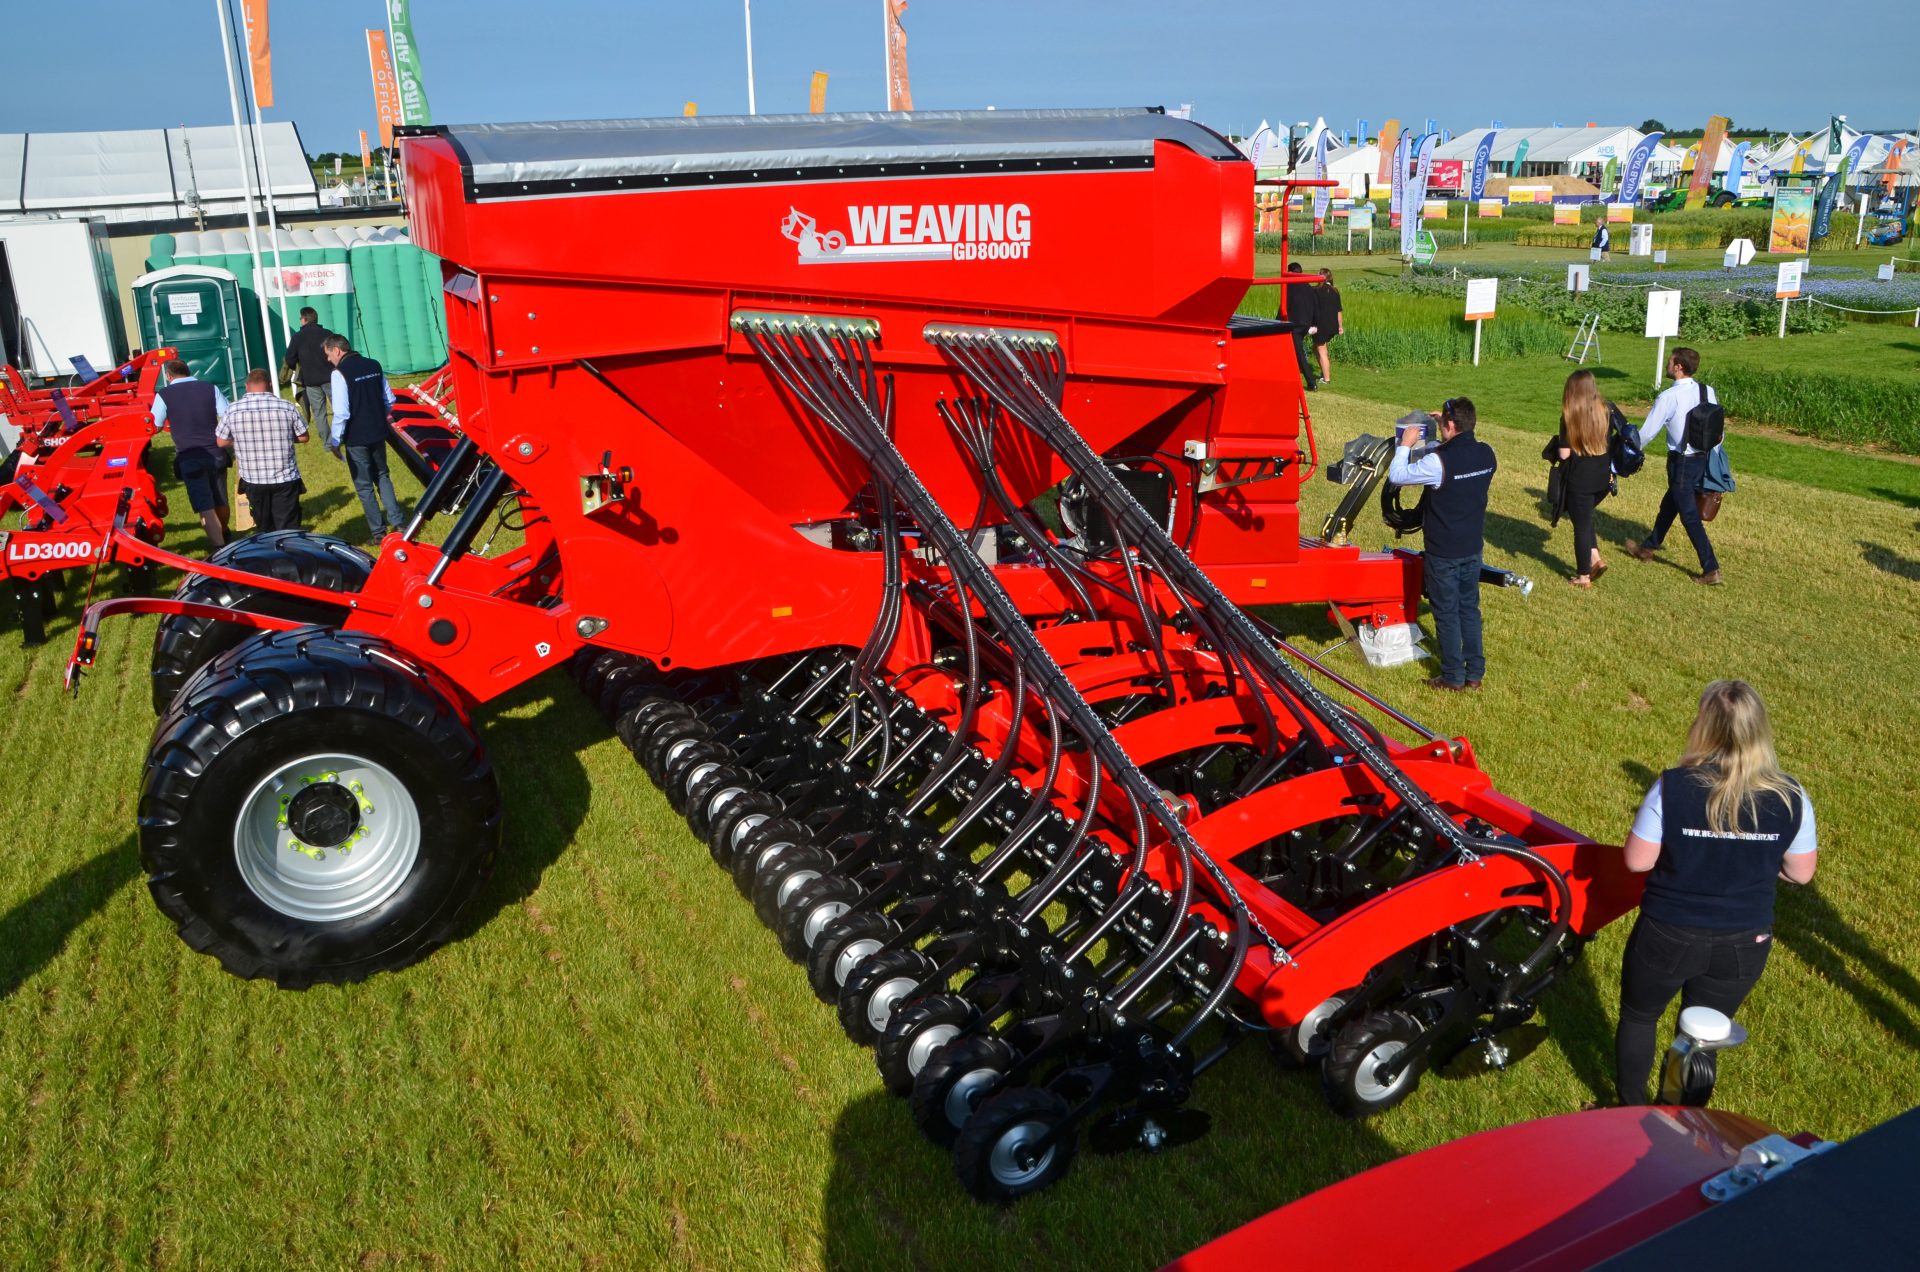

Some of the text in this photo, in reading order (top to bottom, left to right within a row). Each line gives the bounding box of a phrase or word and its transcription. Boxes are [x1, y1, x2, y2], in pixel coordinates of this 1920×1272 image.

[394, 31, 410, 63] AID
[377, 70, 392, 123] OFFICE
[1477, 151, 1486, 167] TAG
[1626, 152, 1646, 194] NIAB TAG
[848, 203, 1031, 244] WEAVING
[953, 242, 1031, 260] GD8000T
[9, 541, 91, 561] LD3000
